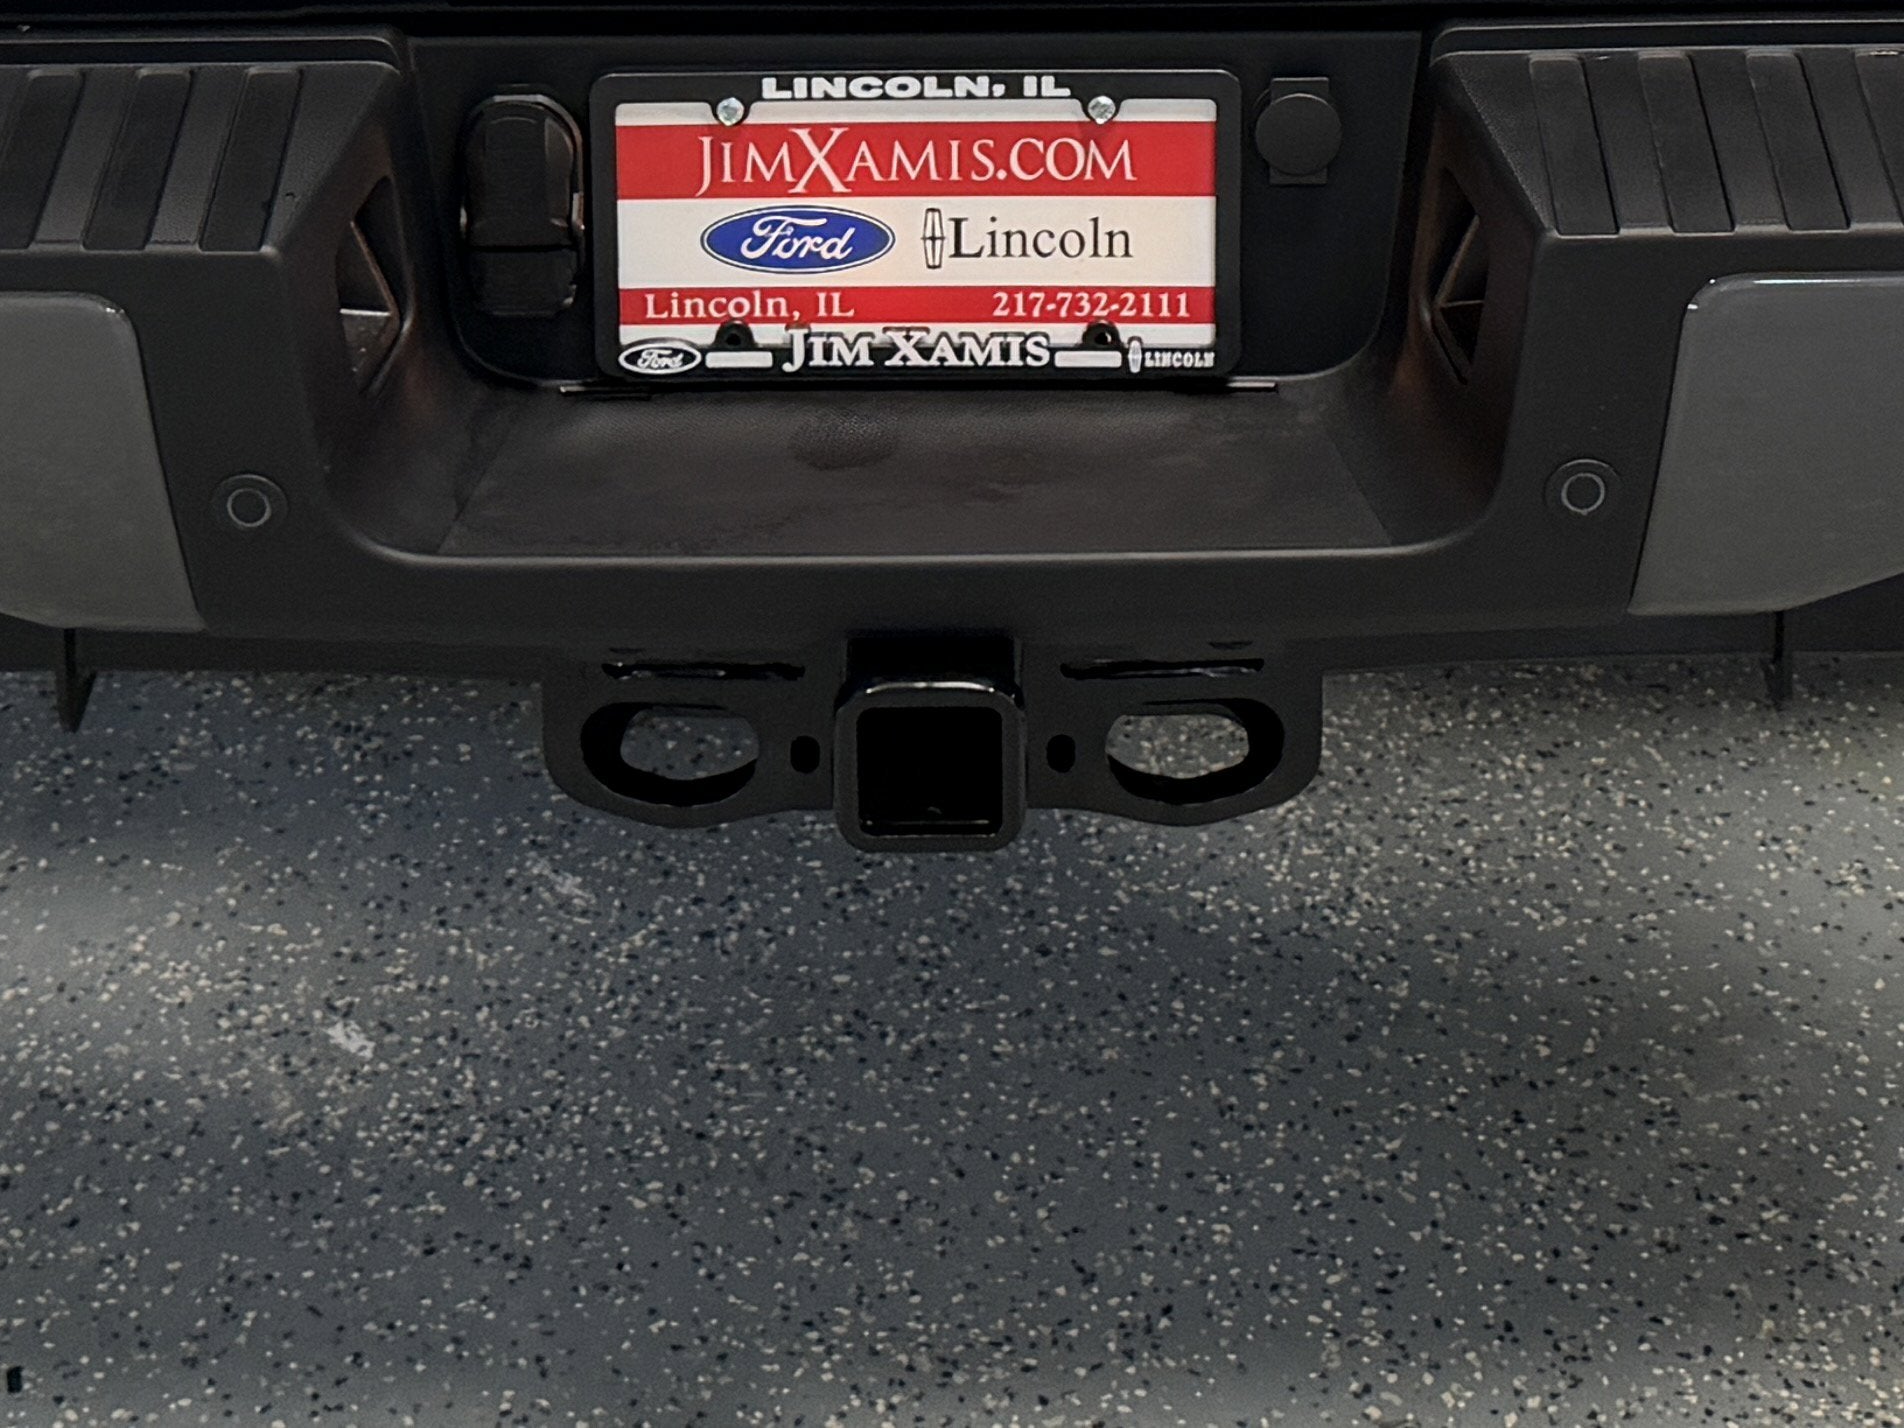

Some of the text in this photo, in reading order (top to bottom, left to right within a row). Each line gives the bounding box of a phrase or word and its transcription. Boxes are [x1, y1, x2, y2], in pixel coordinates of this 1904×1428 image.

[761, 75, 1071, 99] LINCOLN, IL
[740, 214, 1134, 261] Ford Lincoln
[645, 289, 855, 321] Lincoln, IL
[991, 291, 1191, 318] 217-732-2111
[637, 347, 685, 370] Ford
[782, 328, 1051, 373] JIM XAMIS
[1144, 350, 1216, 368] LINCOLN
